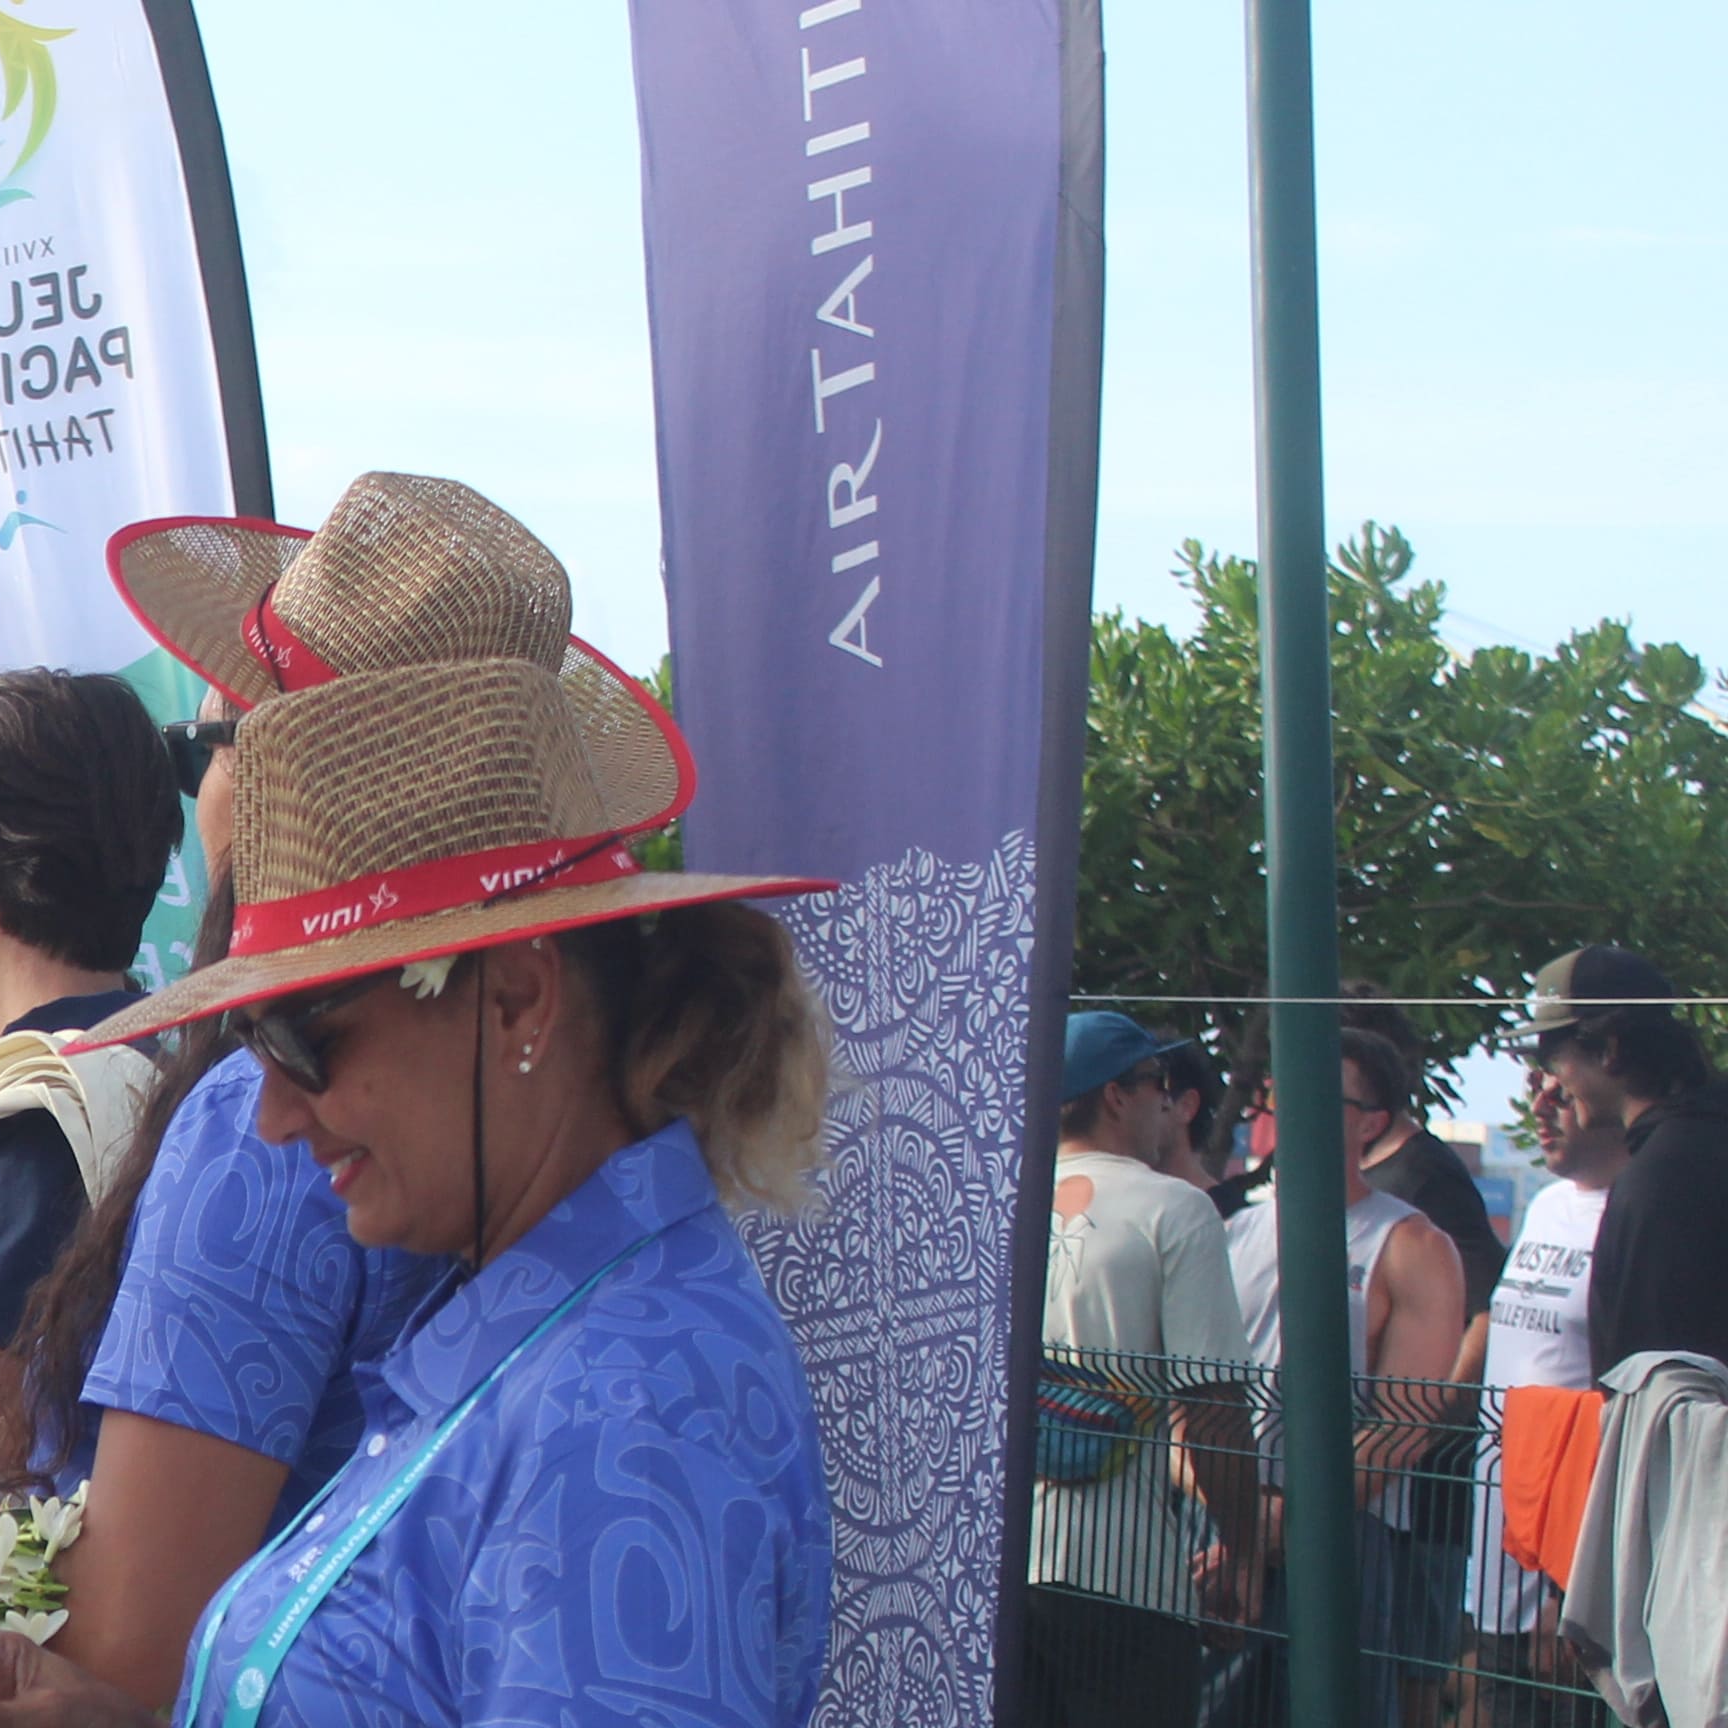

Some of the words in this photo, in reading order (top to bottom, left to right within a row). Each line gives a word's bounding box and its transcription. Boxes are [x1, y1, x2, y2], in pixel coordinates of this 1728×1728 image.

[799, 0, 876, 433] TAHITI
[828, 417, 882, 668] AIR
[1490, 1301, 1562, 1335] OLLEYBALL
